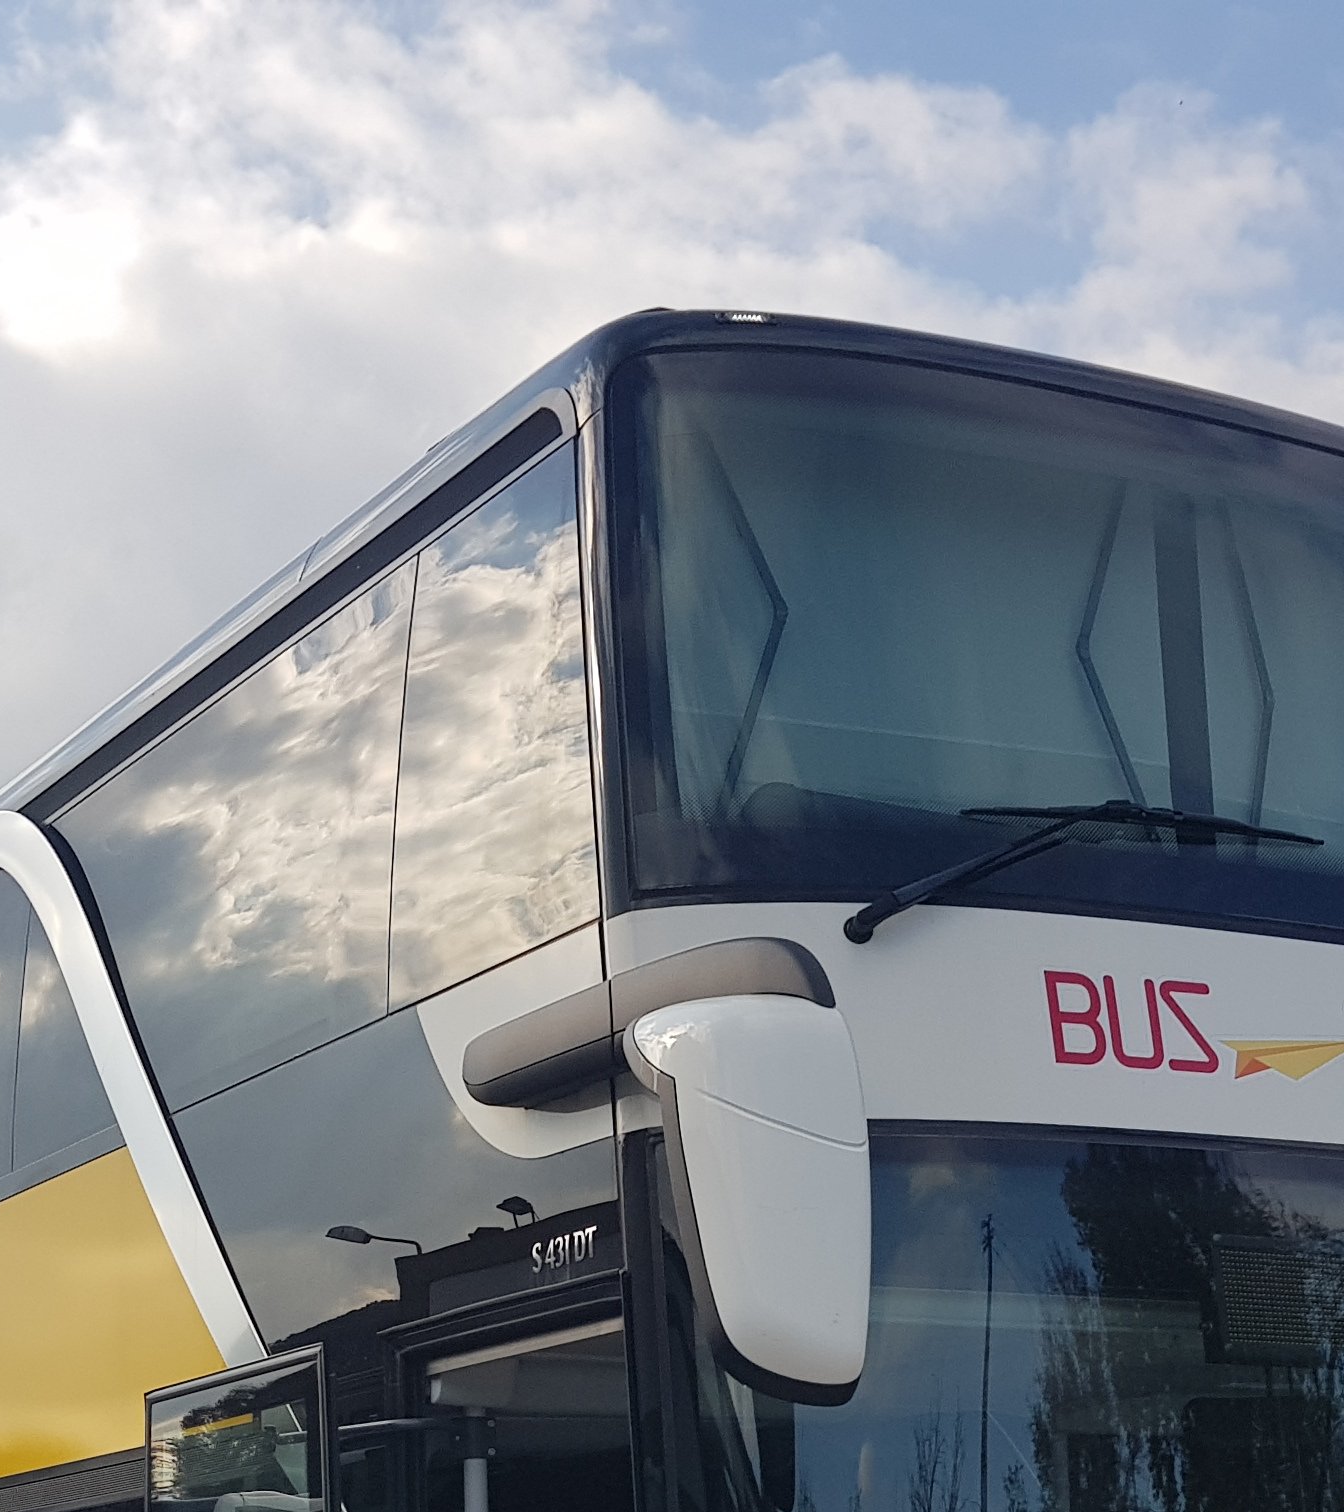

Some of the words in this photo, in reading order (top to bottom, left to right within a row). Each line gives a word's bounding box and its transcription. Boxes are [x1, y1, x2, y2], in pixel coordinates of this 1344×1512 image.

[1042, 969, 1219, 1074] BUS
[531, 1242, 543, 1273] S
[545, 1233, 570, 1270] 431
[571, 1225, 598, 1263] DT
